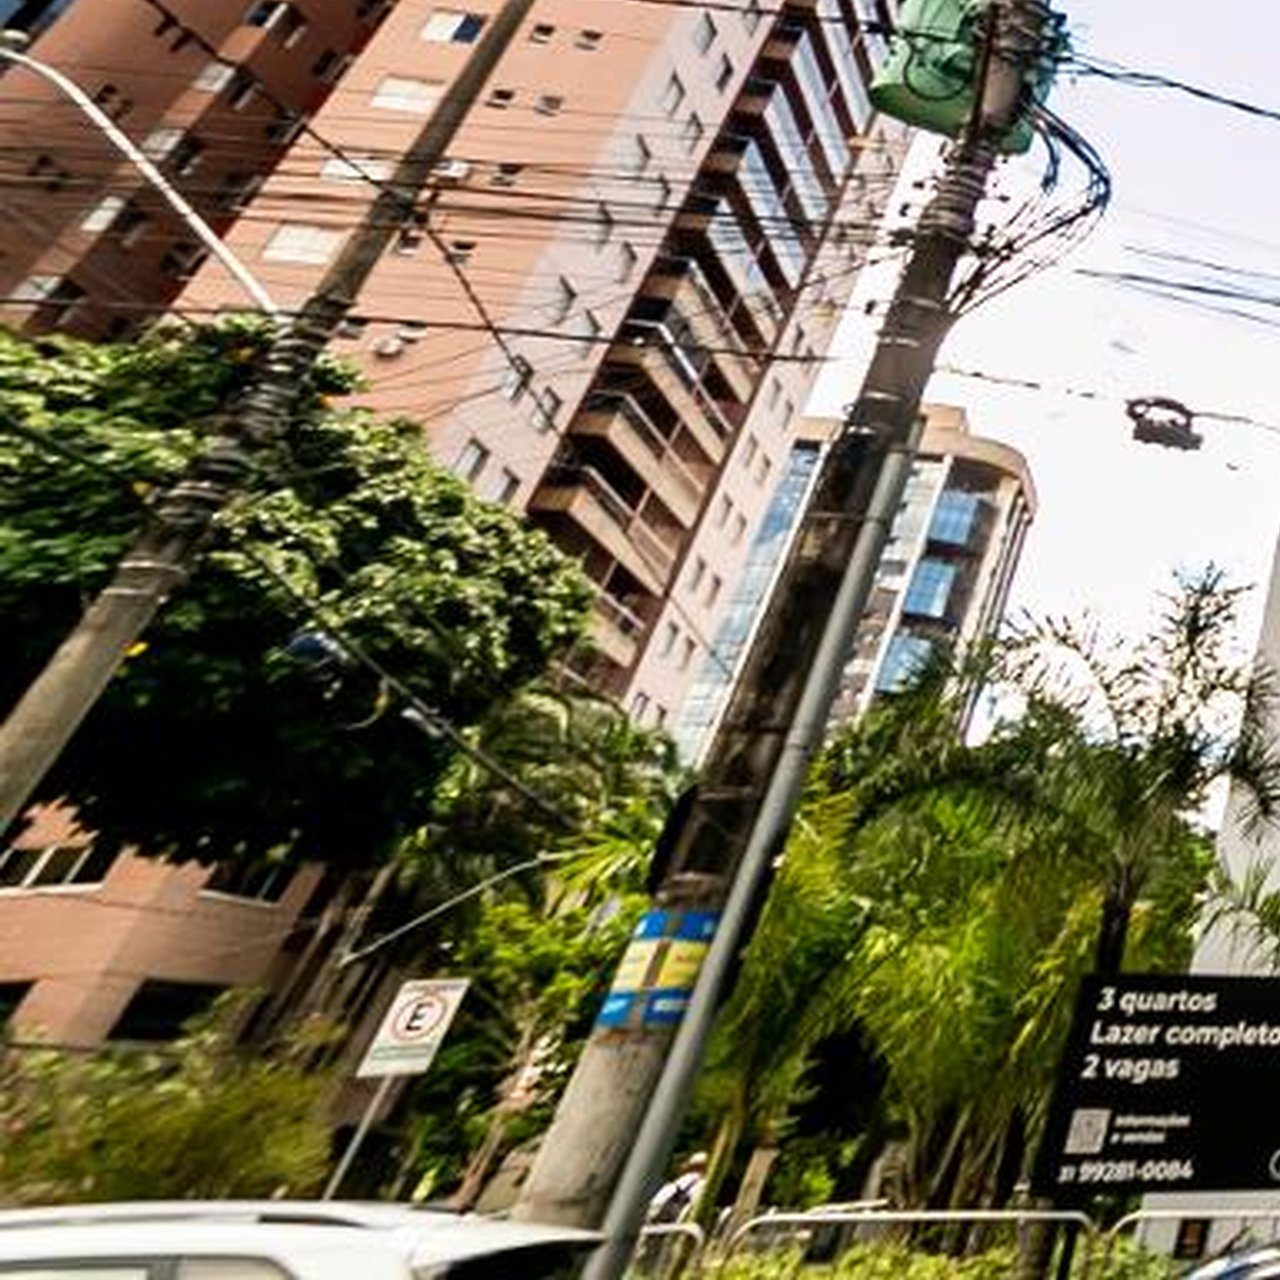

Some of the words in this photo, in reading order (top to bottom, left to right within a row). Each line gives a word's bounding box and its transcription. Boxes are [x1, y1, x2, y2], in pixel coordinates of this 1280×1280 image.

[405, 1001, 434, 1031] E
[1097, 987, 1116, 1011] 3
[1119, 990, 1218, 1017] quartos
[1090, 1021, 1162, 1044] Lazer
[1081, 1053, 1100, 1078] 2
[1104, 1058, 1180, 1084] vagas
